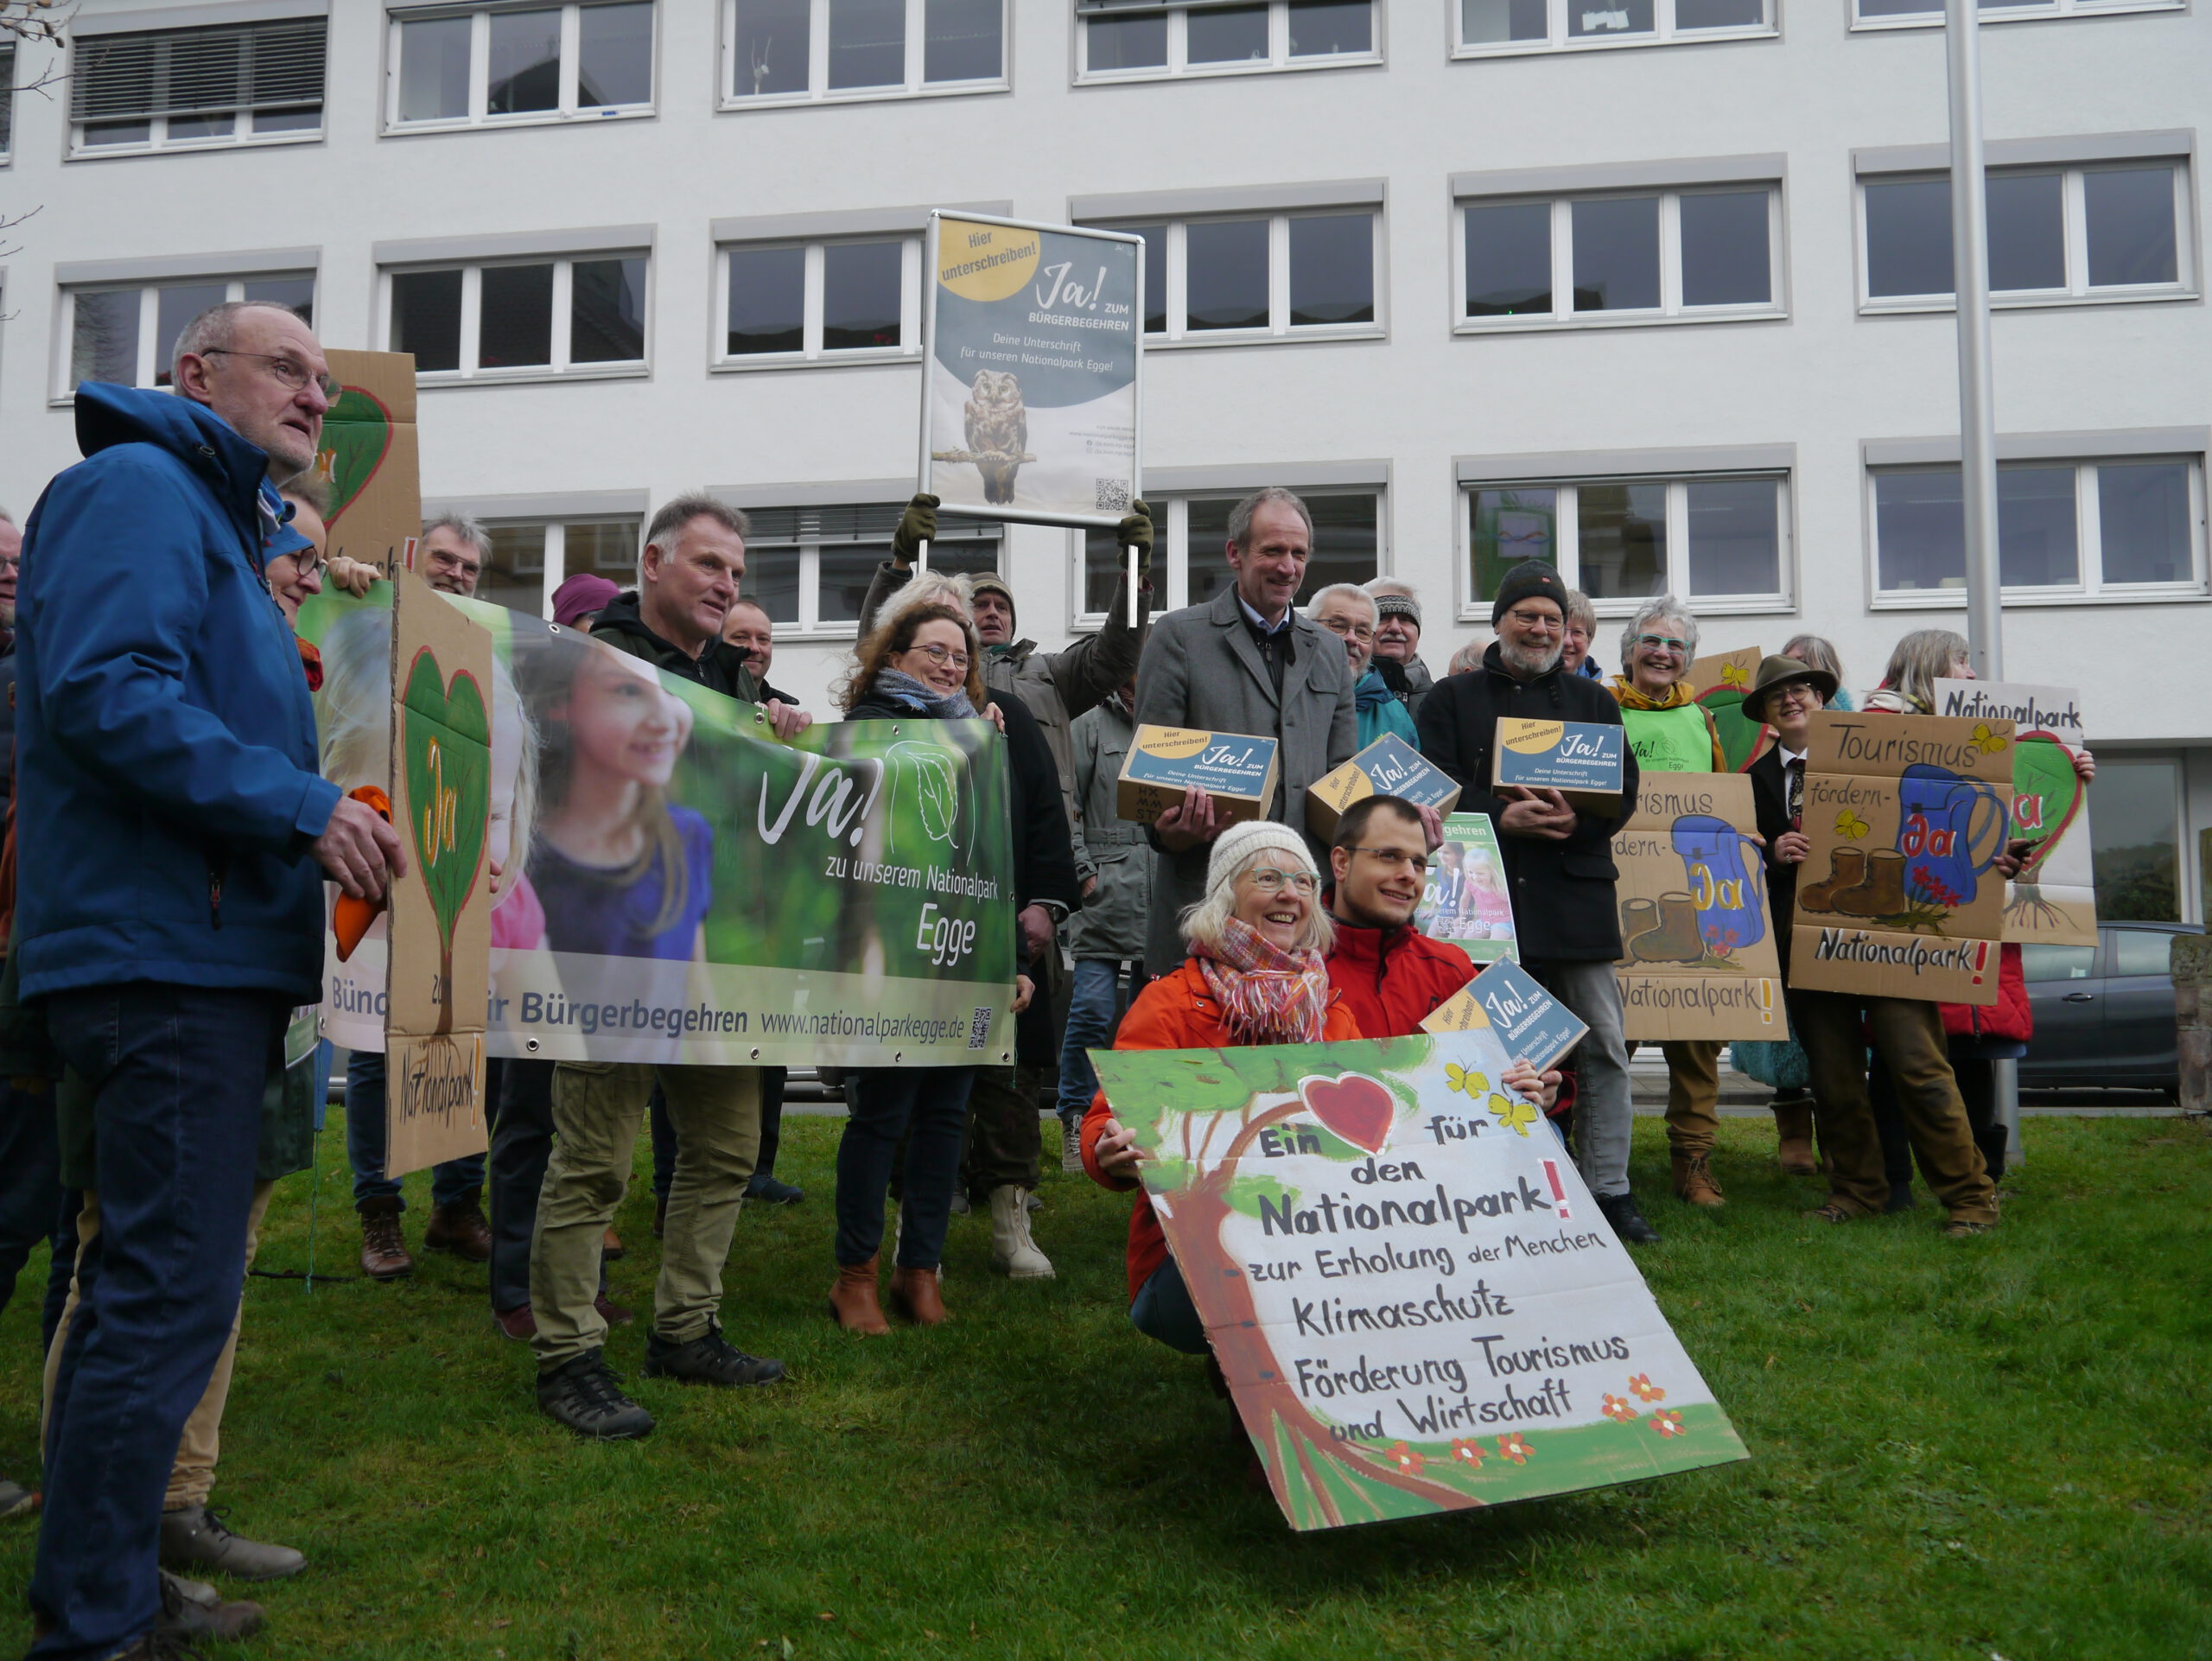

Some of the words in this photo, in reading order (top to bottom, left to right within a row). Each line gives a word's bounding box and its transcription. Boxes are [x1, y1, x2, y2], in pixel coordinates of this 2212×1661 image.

[969, 232, 992, 249] Hier
[942, 242, 1037, 281] unterschreiben!
[1036, 262, 1107, 310] Ja!
[1104, 303, 1129, 315] ZUM
[1028, 311, 1129, 331] BÜRGERBEGEHREN
[961, 347, 976, 359] für
[979, 350, 1018, 362] unseren
[1021, 353, 1084, 369] Nationalpark
[1087, 360, 1113, 372] Egge!
[993, 333, 1020, 346] Deine
[1024, 336, 1082, 353] Unterschrift
[1521, 722, 1535, 730] Hier
[1946, 690, 2083, 731] Nationalpark
[1142, 736, 1209, 749] unterschreiben!
[1505, 726, 1561, 746] unterschreiben!
[1560, 734, 1605, 757] Ja!
[1830, 723, 1980, 767] Tourismus
[1193, 764, 1262, 777] BÜRGERBEGEHREN
[1202, 745, 1253, 767] Ja!
[1370, 754, 1408, 791] Ja!
[1408, 760, 1422, 773] ZUM
[1556, 757, 1618, 767] BÜRGERBEGEHREN
[1156, 775, 1183, 784] unseren
[1187, 773, 1227, 784] Unterschrift
[1329, 777, 1341, 791] Hier
[1551, 777, 1589, 786] Nationalpark
[1553, 769, 1588, 778] Unterschrift
[758, 745, 884, 847] Ja!
[1811, 779, 1891, 807] fördern-
[2012, 792, 2044, 831] a
[1903, 812, 1958, 857] Ja
[825, 855, 846, 878] zu
[853, 860, 920, 890] unserem
[926, 864, 998, 904] Nationalpark
[917, 902, 976, 966] Egge
[1460, 917, 1491, 934] Egge
[1815, 926, 1992, 986] Nationalpark!
[520, 990, 748, 1038] Bürgerbegehren
[761, 1009, 964, 1045] www.nationalparkegge.de
[1485, 980, 1529, 1029] Ja!
[1528, 990, 1543, 1004] ZUM
[1507, 999, 1554, 1041] BÜRGERBEGEHREN
[1521, 1030, 1548, 1055] Unterschrift
[1259, 1123, 1322, 1159] Ein
[1425, 1115, 1490, 1146] für
[1351, 1157, 1426, 1186] den
[1257, 1157, 1574, 1237] Nationalpark!
[1249, 1258, 1302, 1282] zur
[1315, 1242, 1455, 1279] Erholung
[1468, 1244, 1501, 1263] der
[1505, 1229, 1606, 1261] Menchen
[1293, 1279, 1515, 1338] Klimaschutz
[1294, 1354, 1468, 1401] Förderung
[1471, 1332, 1630, 1379] Tourismus
[1330, 1410, 1385, 1442] und
[1396, 1378, 1573, 1435] Wirtschaft
